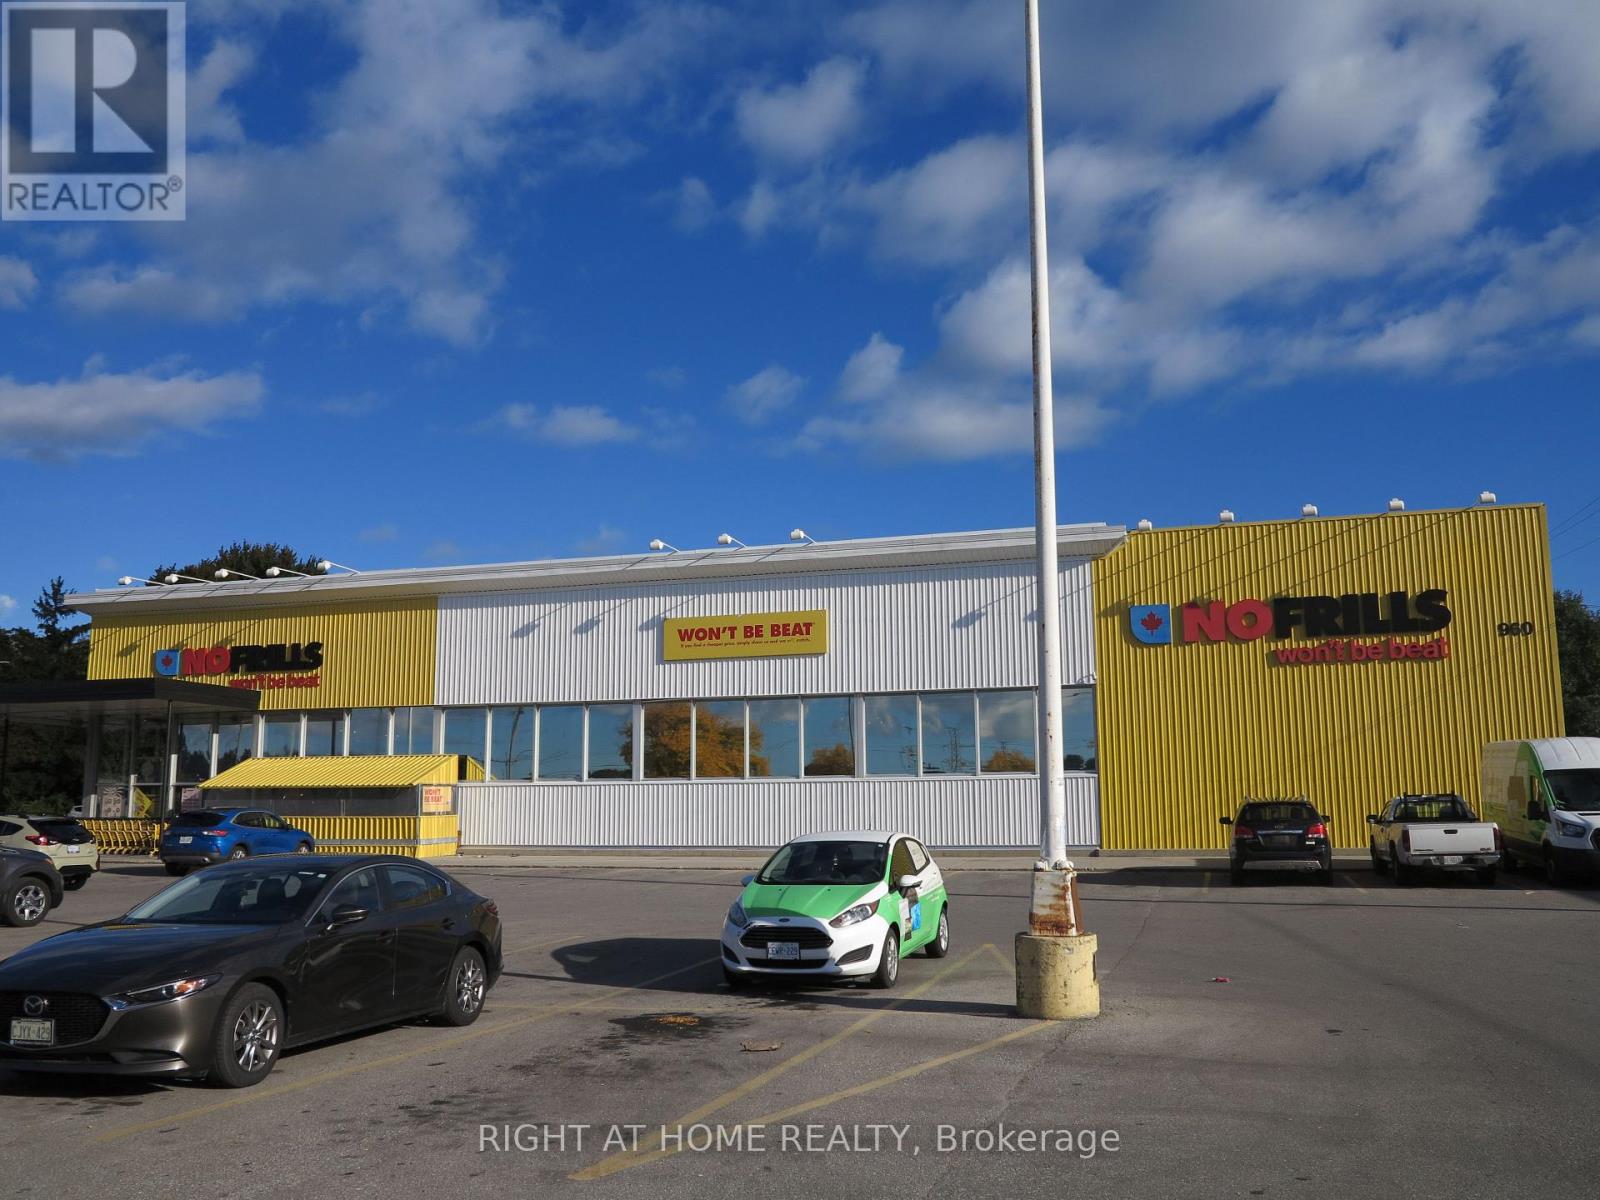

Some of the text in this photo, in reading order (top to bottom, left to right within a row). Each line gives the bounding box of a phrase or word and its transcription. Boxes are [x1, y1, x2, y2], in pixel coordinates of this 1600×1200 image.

[677, 622, 813, 642] WON'T BE BEAT
[1276, 637, 1450, 664] won't be beat
[286, 672, 321, 688] beat
